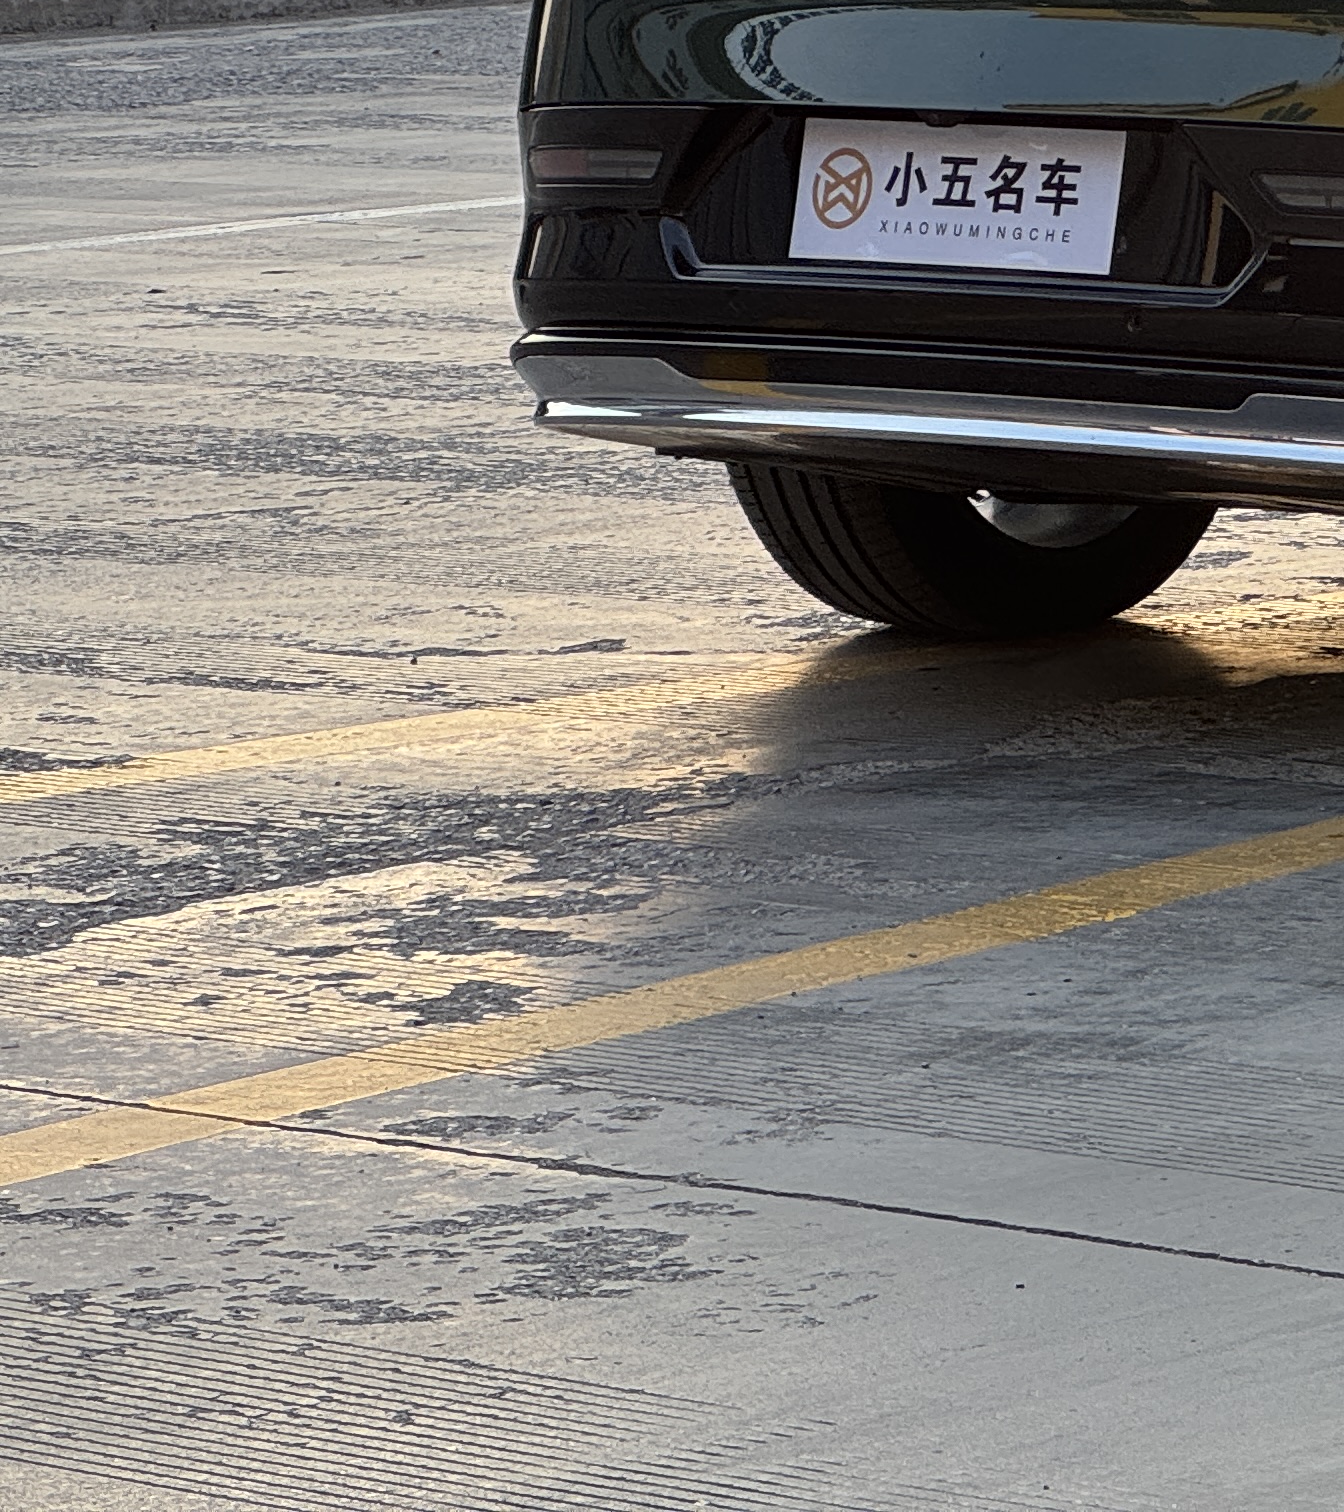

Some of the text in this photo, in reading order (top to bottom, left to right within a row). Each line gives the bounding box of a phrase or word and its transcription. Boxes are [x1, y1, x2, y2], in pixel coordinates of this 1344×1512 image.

[884, 151, 1082, 216] 小五名车
[878, 219, 1071, 243] XIAOWUMINGCHE
